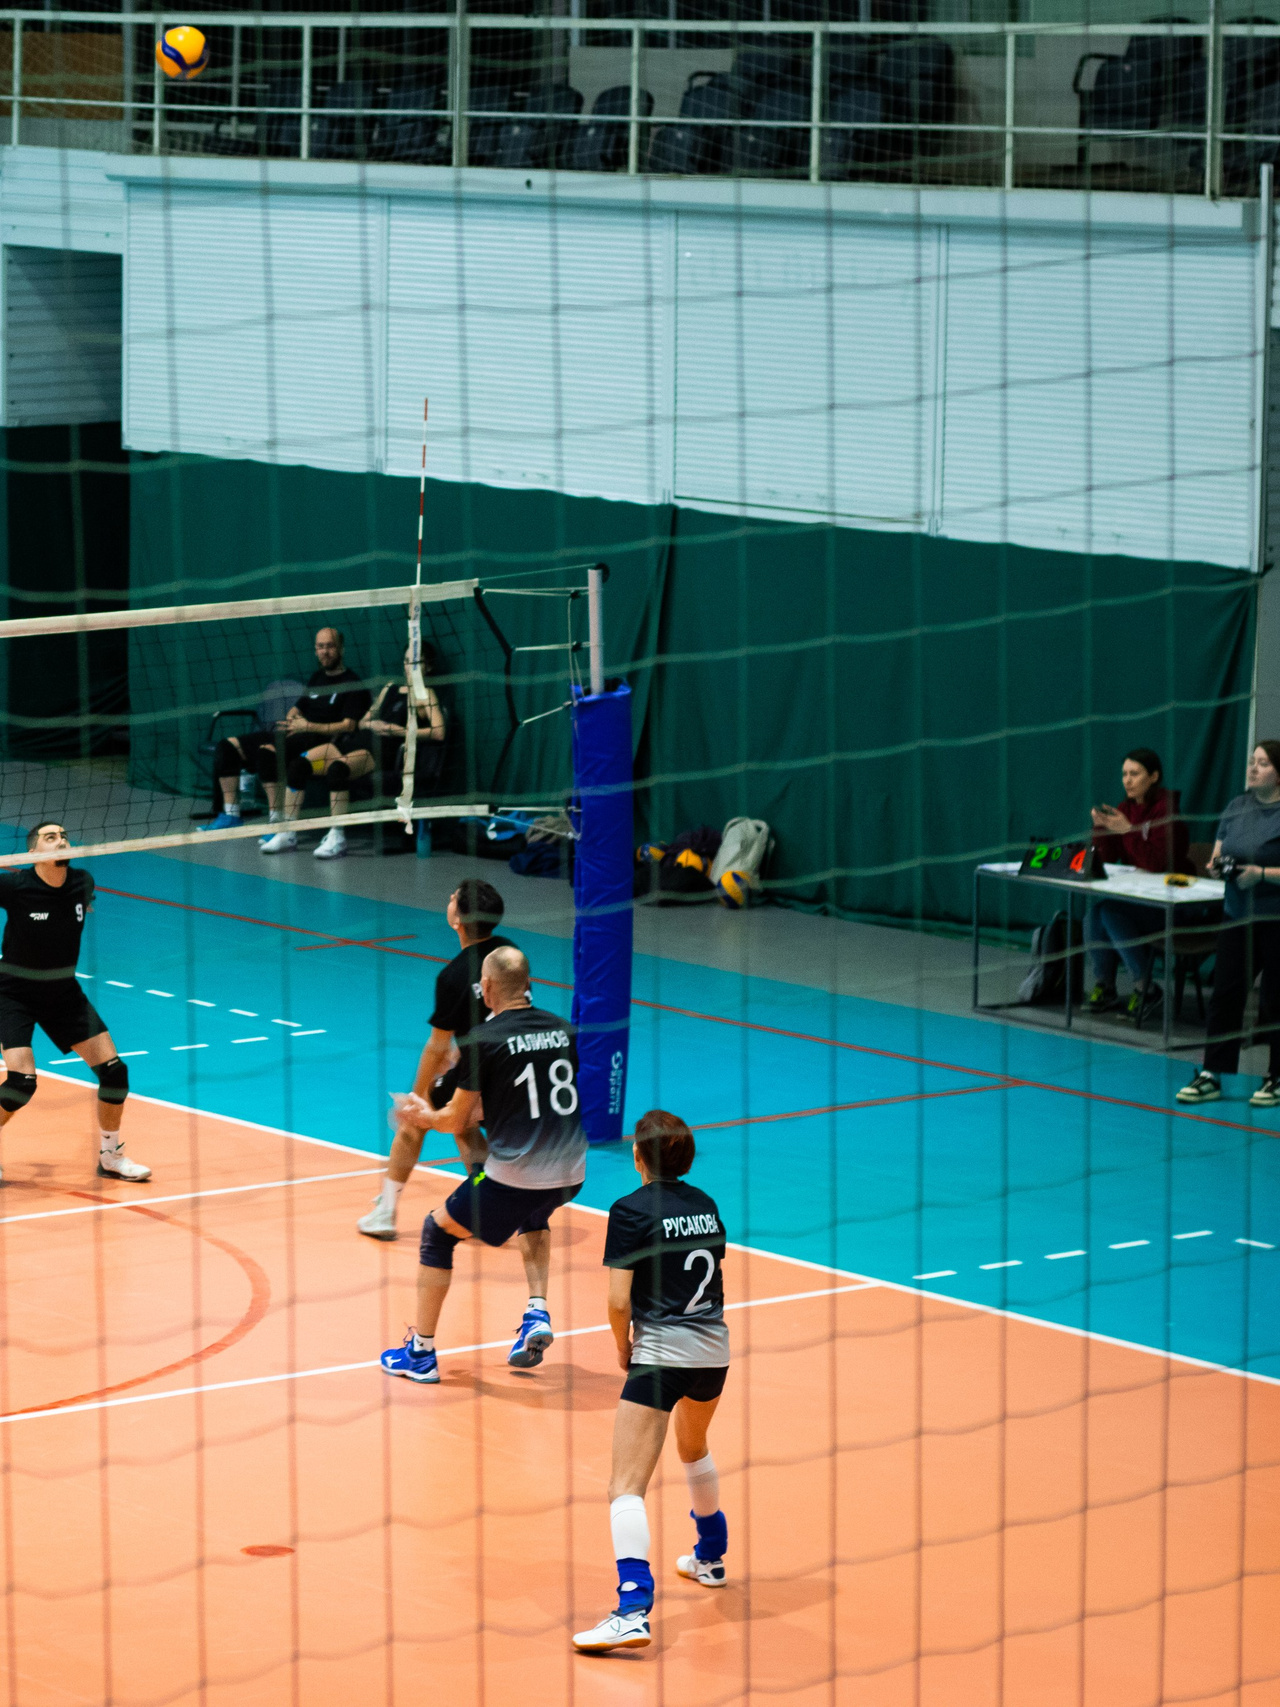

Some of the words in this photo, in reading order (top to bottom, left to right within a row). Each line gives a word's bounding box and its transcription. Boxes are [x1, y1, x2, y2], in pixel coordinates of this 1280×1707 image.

[1029, 844, 1049, 868] 2
[75, 903, 84, 922] 9
[507, 1030, 570, 1055] ГАЛИНОВ
[513, 1059, 578, 1119] 18
[662, 1213, 720, 1239] РУСАКОВА
[683, 1249, 715, 1315] 2
